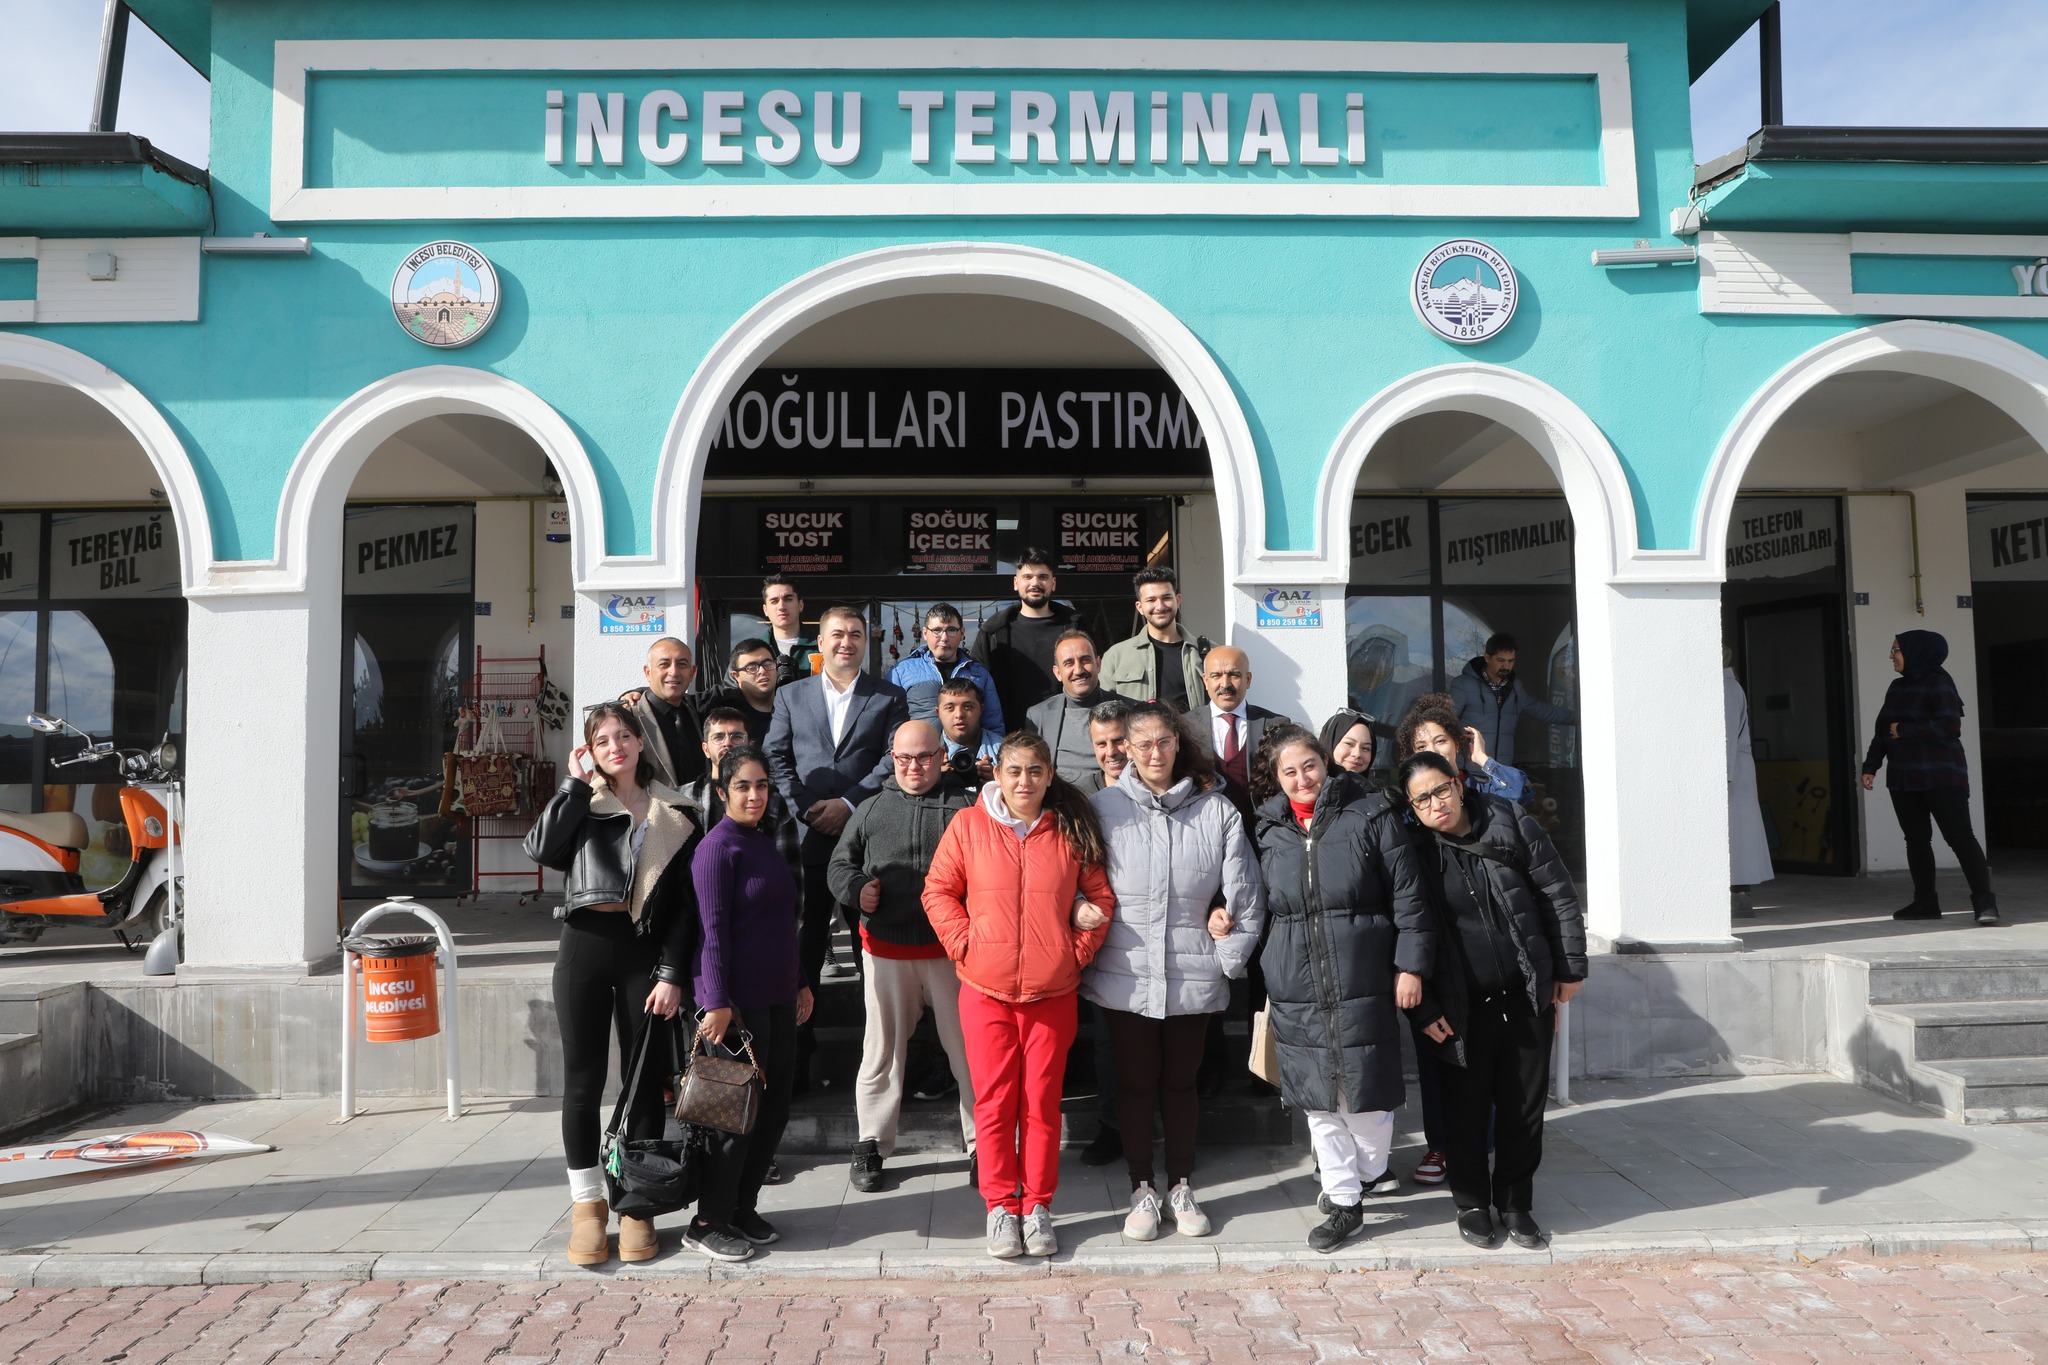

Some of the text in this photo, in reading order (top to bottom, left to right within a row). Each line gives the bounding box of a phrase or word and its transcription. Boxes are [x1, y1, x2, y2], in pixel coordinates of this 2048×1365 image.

[405, 244, 484, 272] İNCESU BELEDİYESİ
[1421, 266, 1433, 310] KAYSERİ
[1453, 324, 1484, 337] 1869
[1001, 390, 1206, 449] PASTIRM
[765, 513, 843, 528] SUCUK
[910, 509, 989, 529] SOĞUK
[1061, 513, 1138, 529] SUCUK
[1742, 509, 1803, 540] TELEFON
[69, 514, 162, 567] TEREYAĞ
[358, 523, 458, 575] PEKMEZ
[775, 532, 833, 547] TOST
[909, 530, 991, 553] İÇECEK
[1061, 532, 1139, 547] EKMEK
[1350, 515, 1412, 559] ECEK
[1447, 518, 1568, 566] ATIŞTIRMALIK
[1726, 527, 1832, 568] AKSESUARLARI
[100, 556, 141, 590] BAL
[602, 625, 608, 633] 0
[609, 625, 624, 633] 850
[625, 624, 640, 632] 259
[641, 624, 651, 632] 62
[368, 979, 416, 996] İNCESU
[365, 993, 427, 1013] BELEDİYESİ
